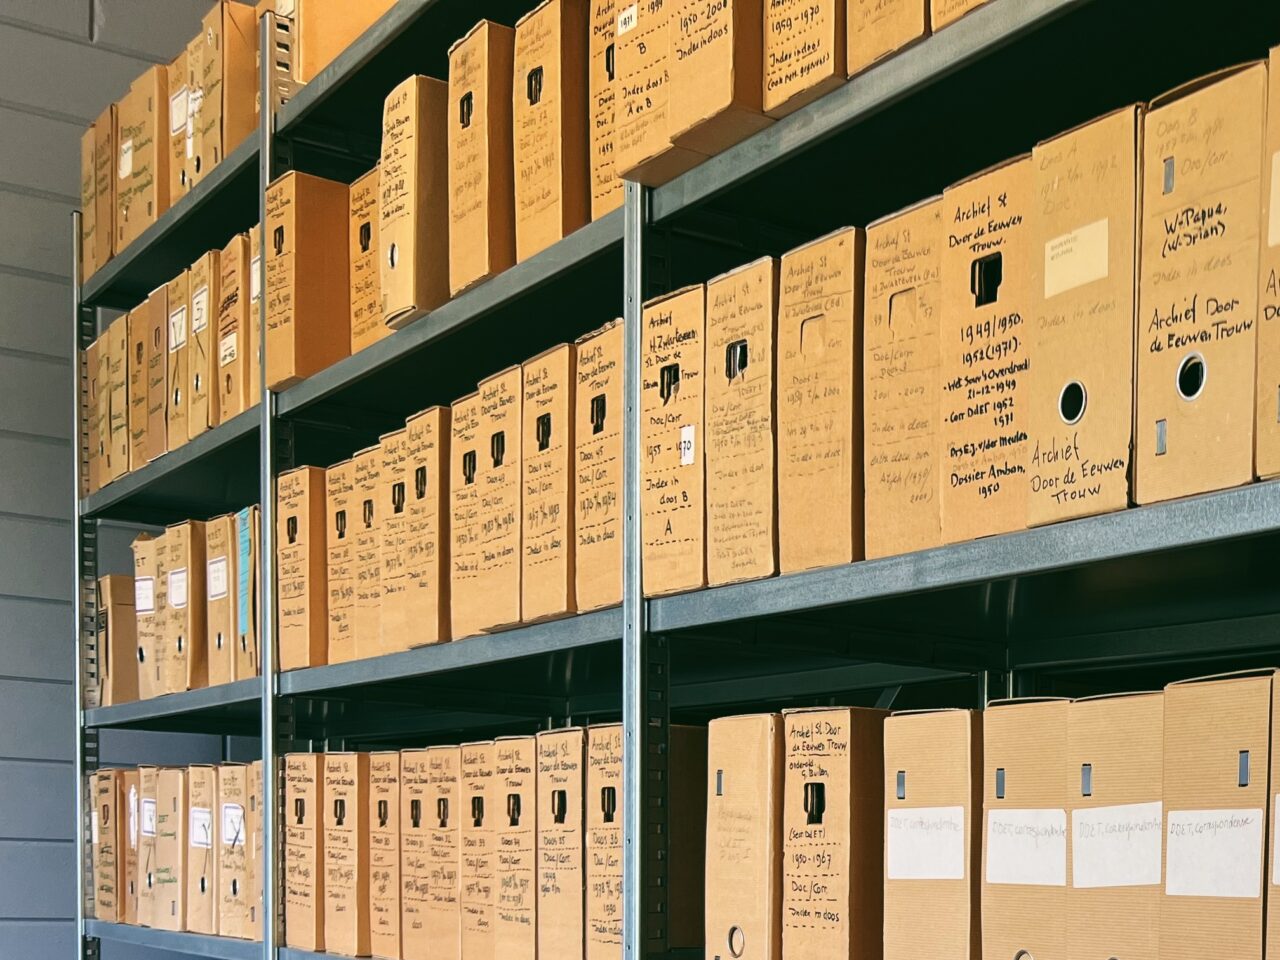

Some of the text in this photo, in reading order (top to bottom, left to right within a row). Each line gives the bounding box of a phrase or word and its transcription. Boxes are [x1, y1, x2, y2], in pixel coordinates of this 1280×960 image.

[708, 25, 728, 41] doos
[637, 43, 646, 54] B
[646, 77, 662, 89] doos
[646, 98, 651, 108] B
[954, 202, 990, 224] Archief
[949, 214, 1022, 248] Door de Eeuwen
[1149, 294, 1240, 332] Archief Door
[1150, 336, 1164, 353] de
[1212, 321, 1253, 341] Trouw
[655, 354, 670, 364] Door
[1032, 432, 1079, 466] Archief
[951, 469, 986, 487] Dossier
[1031, 458, 1125, 493] Door de Eeuwen
[660, 492, 688, 505] doos B
[1052, 485, 1101, 504] Trouw
[665, 519, 672, 536] A
[825, 722, 841, 735] Door
[827, 739, 847, 750] Trouw
[599, 768, 620, 779] Trouw
